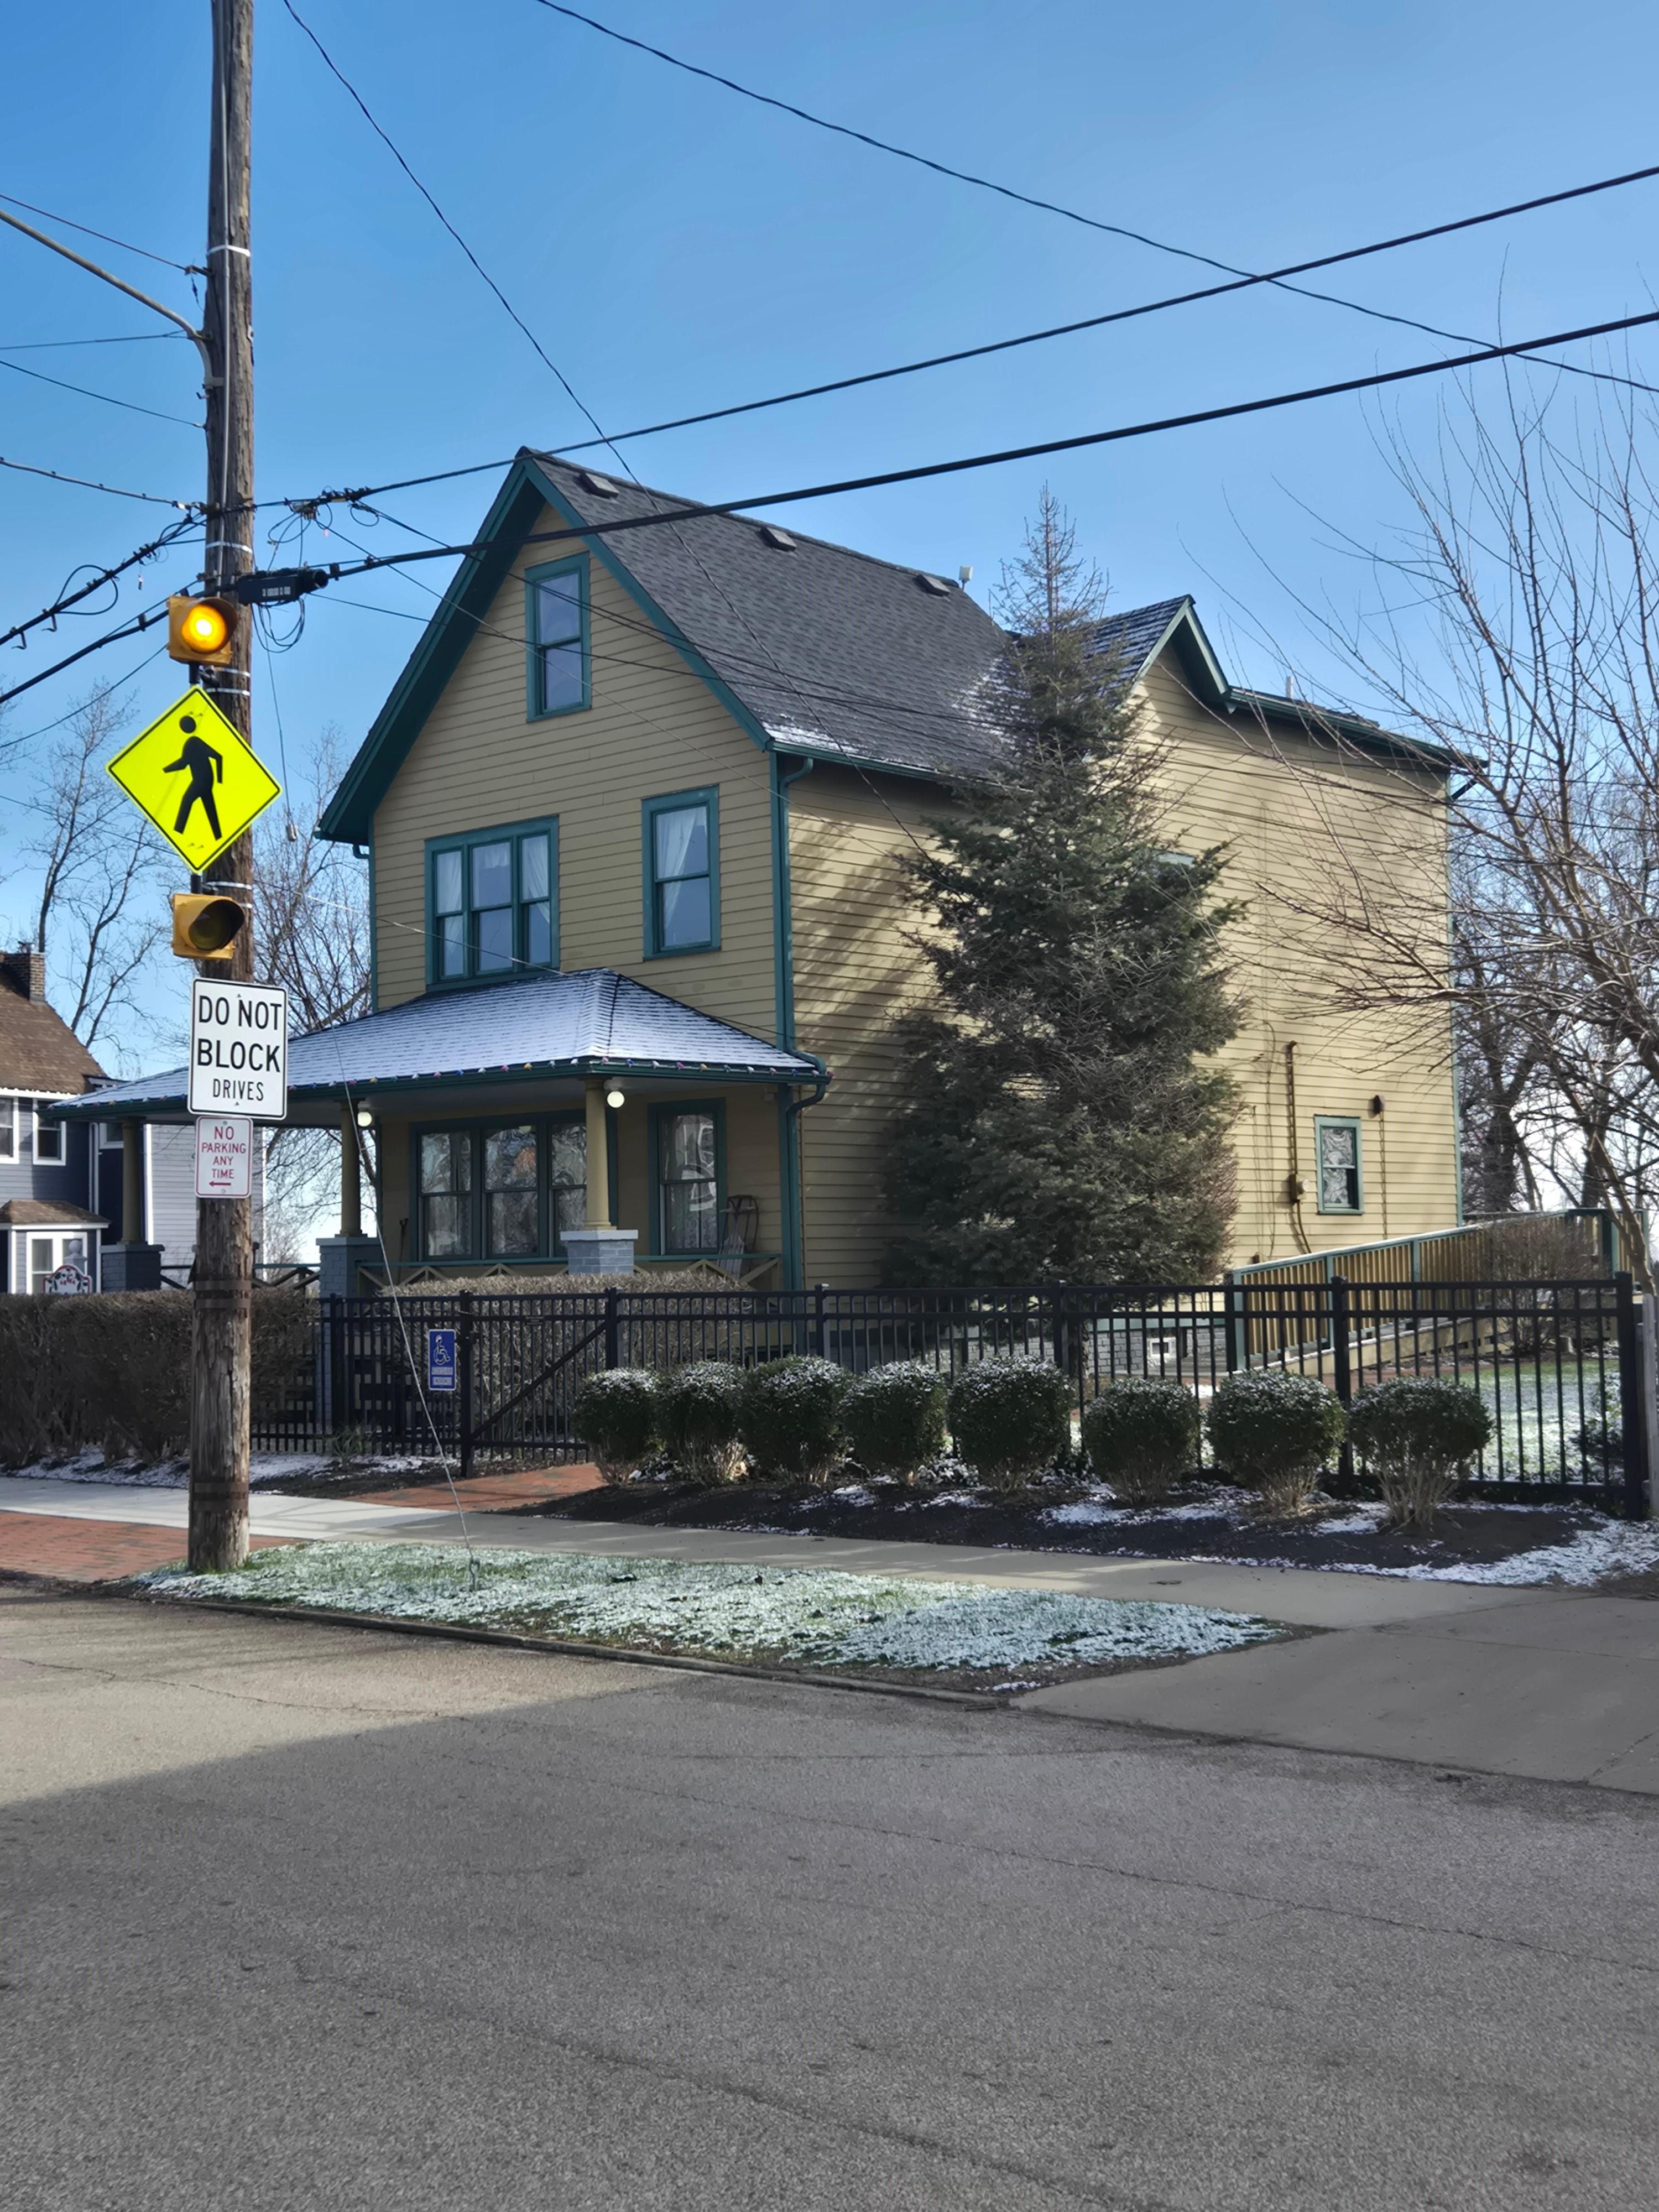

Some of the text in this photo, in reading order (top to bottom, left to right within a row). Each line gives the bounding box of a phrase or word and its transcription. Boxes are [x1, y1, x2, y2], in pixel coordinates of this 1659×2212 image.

[199, 995, 282, 1030] DO NOT
[197, 1038, 280, 1073] BLOCK
[213, 1078, 264, 1101] DRIVES
[214, 1126, 234, 1140] NO
[201, 1142, 246, 1154] PARKING
[213, 1156, 233, 1165] ANY
[212, 1168, 234, 1179] TIME
